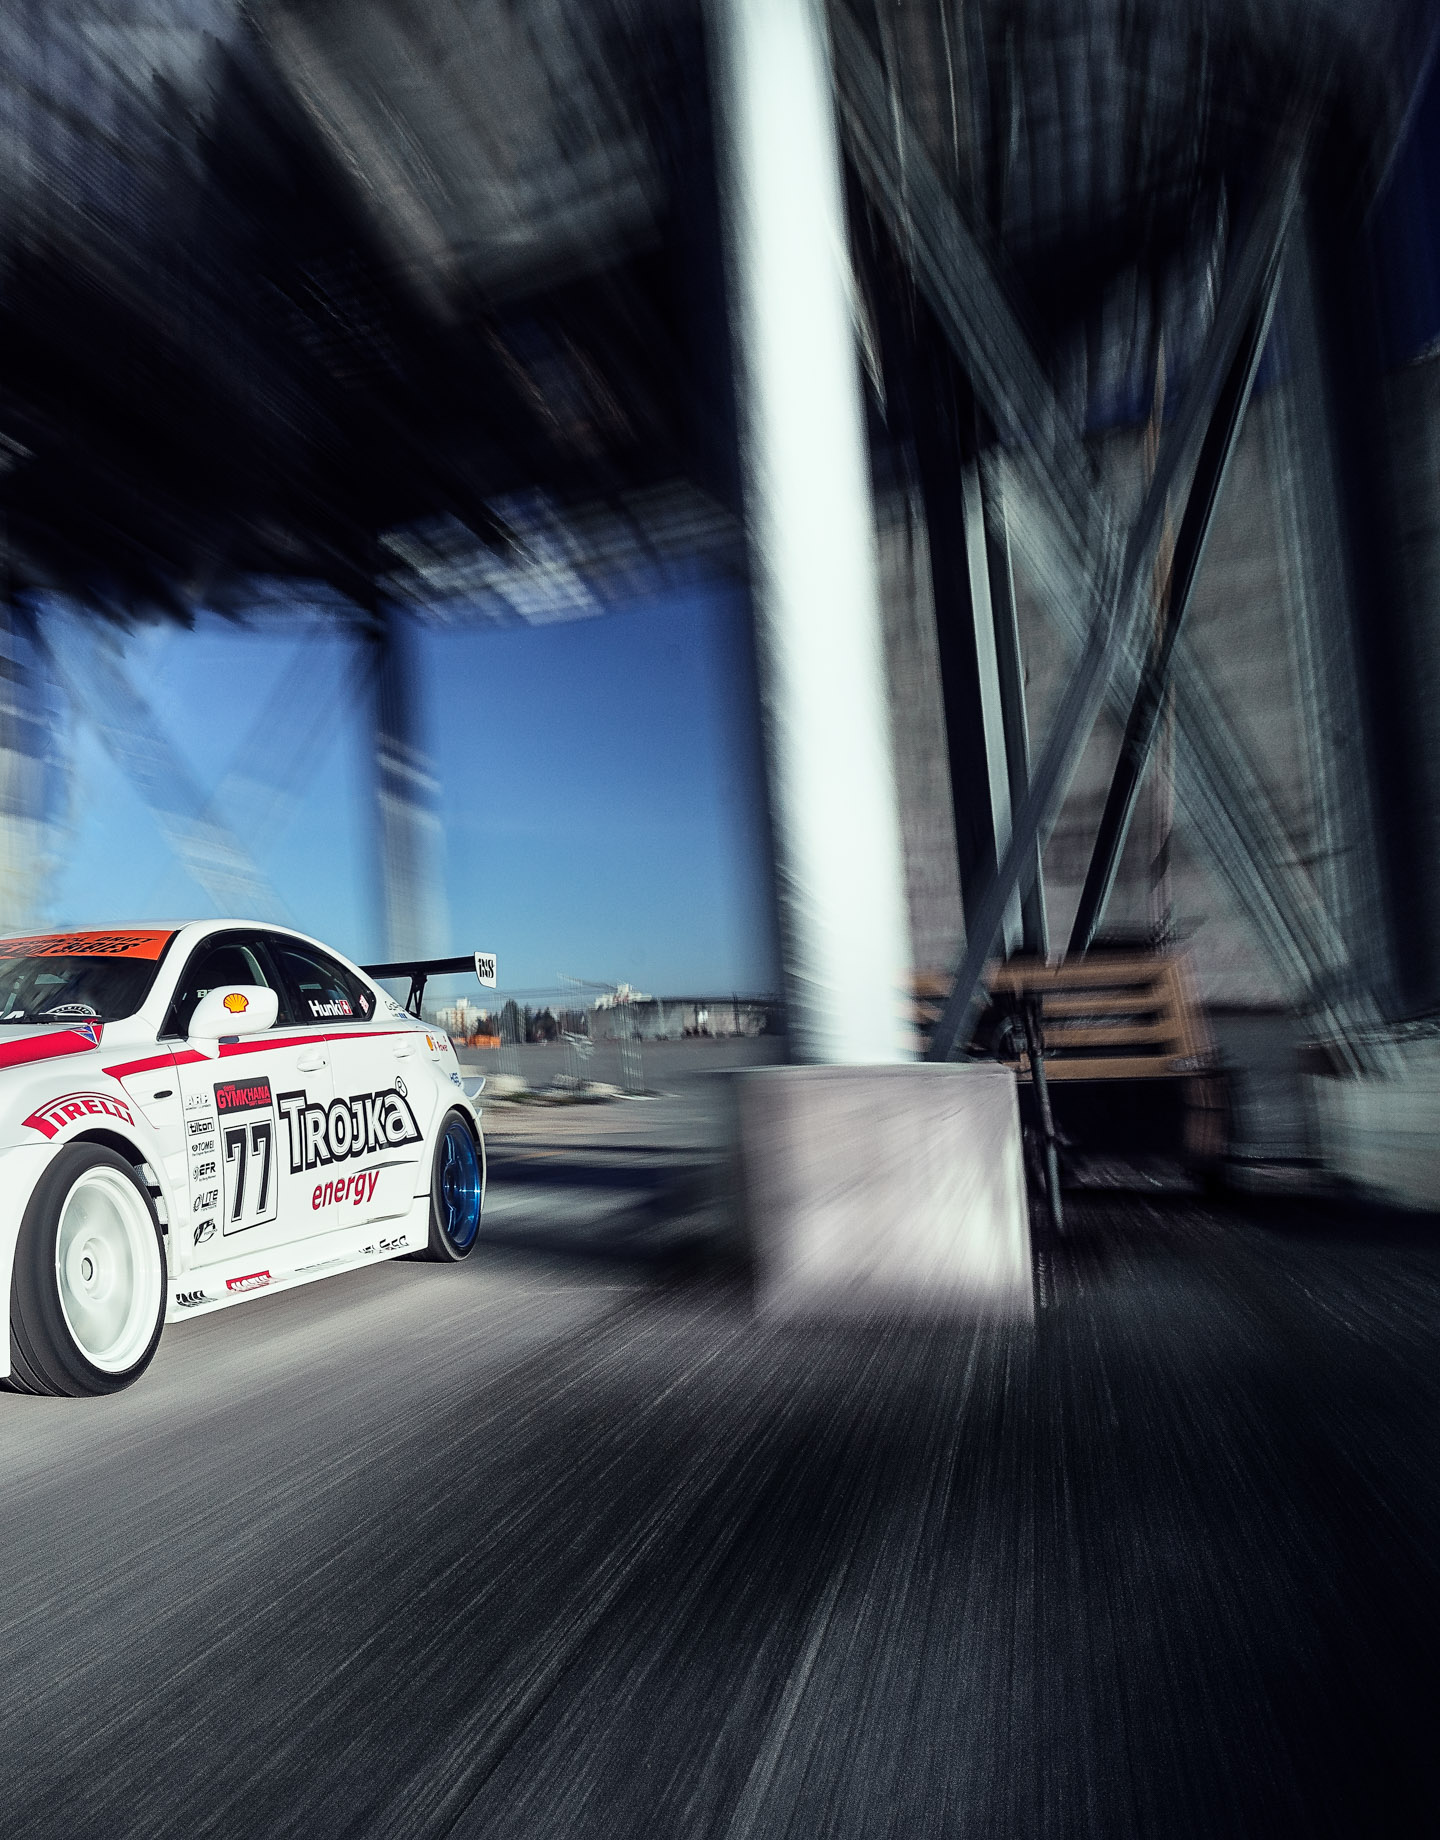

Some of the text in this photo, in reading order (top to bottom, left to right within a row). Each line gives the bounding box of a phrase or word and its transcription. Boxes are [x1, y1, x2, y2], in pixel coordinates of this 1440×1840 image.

[308, 999, 345, 1018] Hunki
[216, 1085, 271, 1109] GYMKHANA
[21, 1091, 136, 1140] PIRELLI
[189, 1121, 213, 1134] tilton
[197, 1139, 215, 1152] TOMEI
[199, 1161, 216, 1177] EFR
[222, 1118, 274, 1223] 77
[312, 1170, 380, 1211] energy
